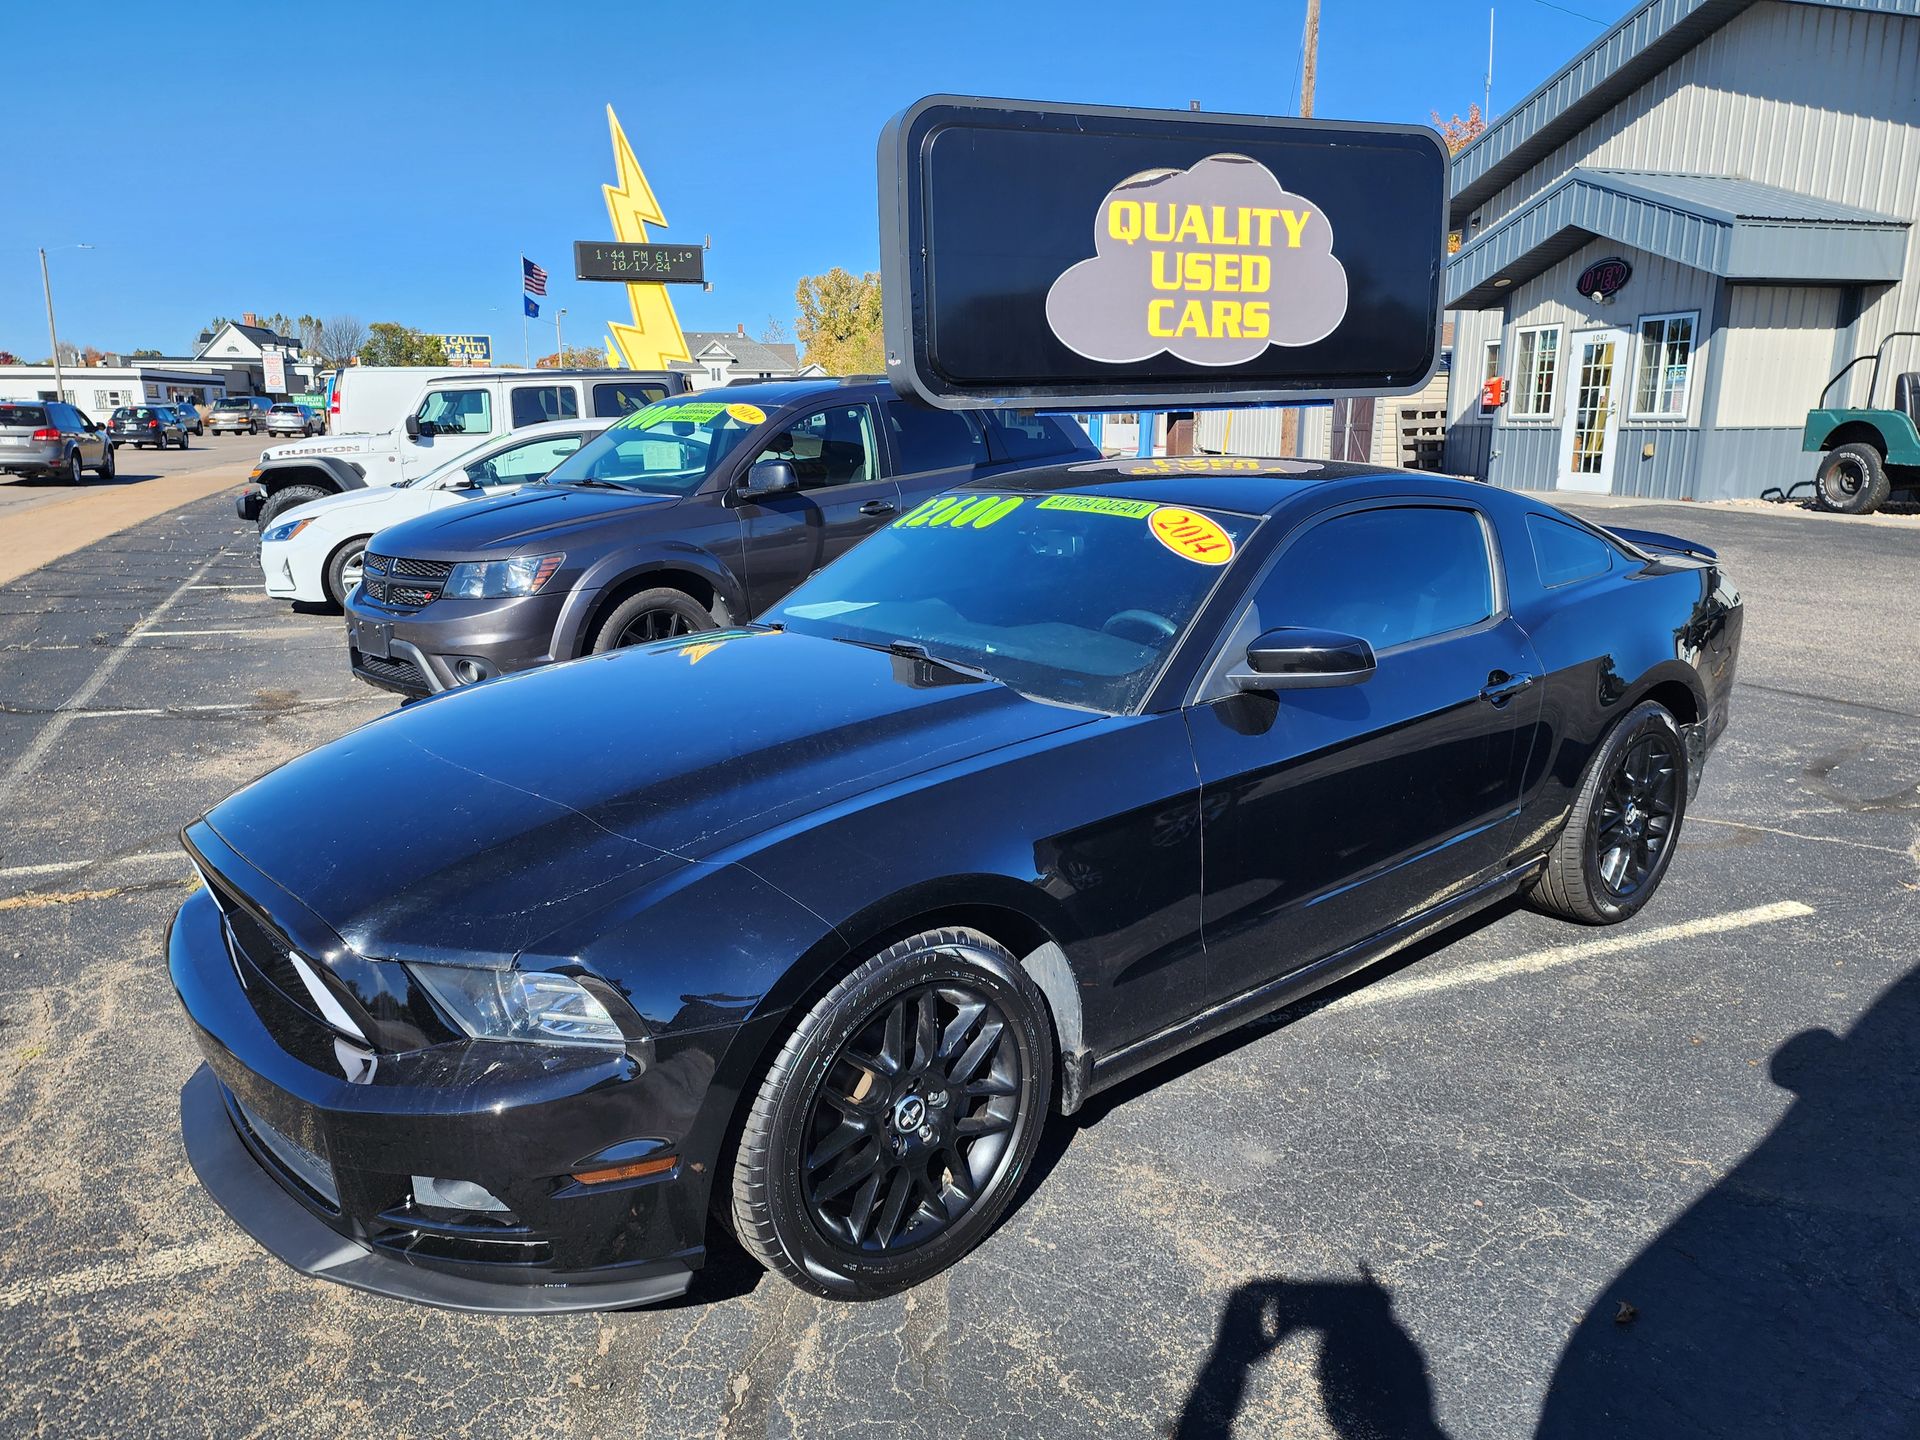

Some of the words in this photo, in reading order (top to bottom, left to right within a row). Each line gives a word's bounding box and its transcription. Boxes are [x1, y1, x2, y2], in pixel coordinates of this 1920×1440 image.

[1108, 200, 1312, 248] QUALITY
[596, 249, 625, 260] 1:44
[633, 250, 648, 261] PM
[612, 260, 671, 272] 10/17/24
[1151, 251, 1271, 293] USED
[1147, 299, 1271, 339] CARS
[1592, 333, 1608, 342] 1047
[1670, 370, 1687, 379] OPEN
[731, 405, 761, 420] 2014
[278, 445, 361, 456] RUBICON
[892, 495, 1025, 529] 12600
[1047, 496, 1095, 509] EXTRA
[1095, 500, 1149, 515] CLEAN
[1158, 515, 1227, 555] 2014
